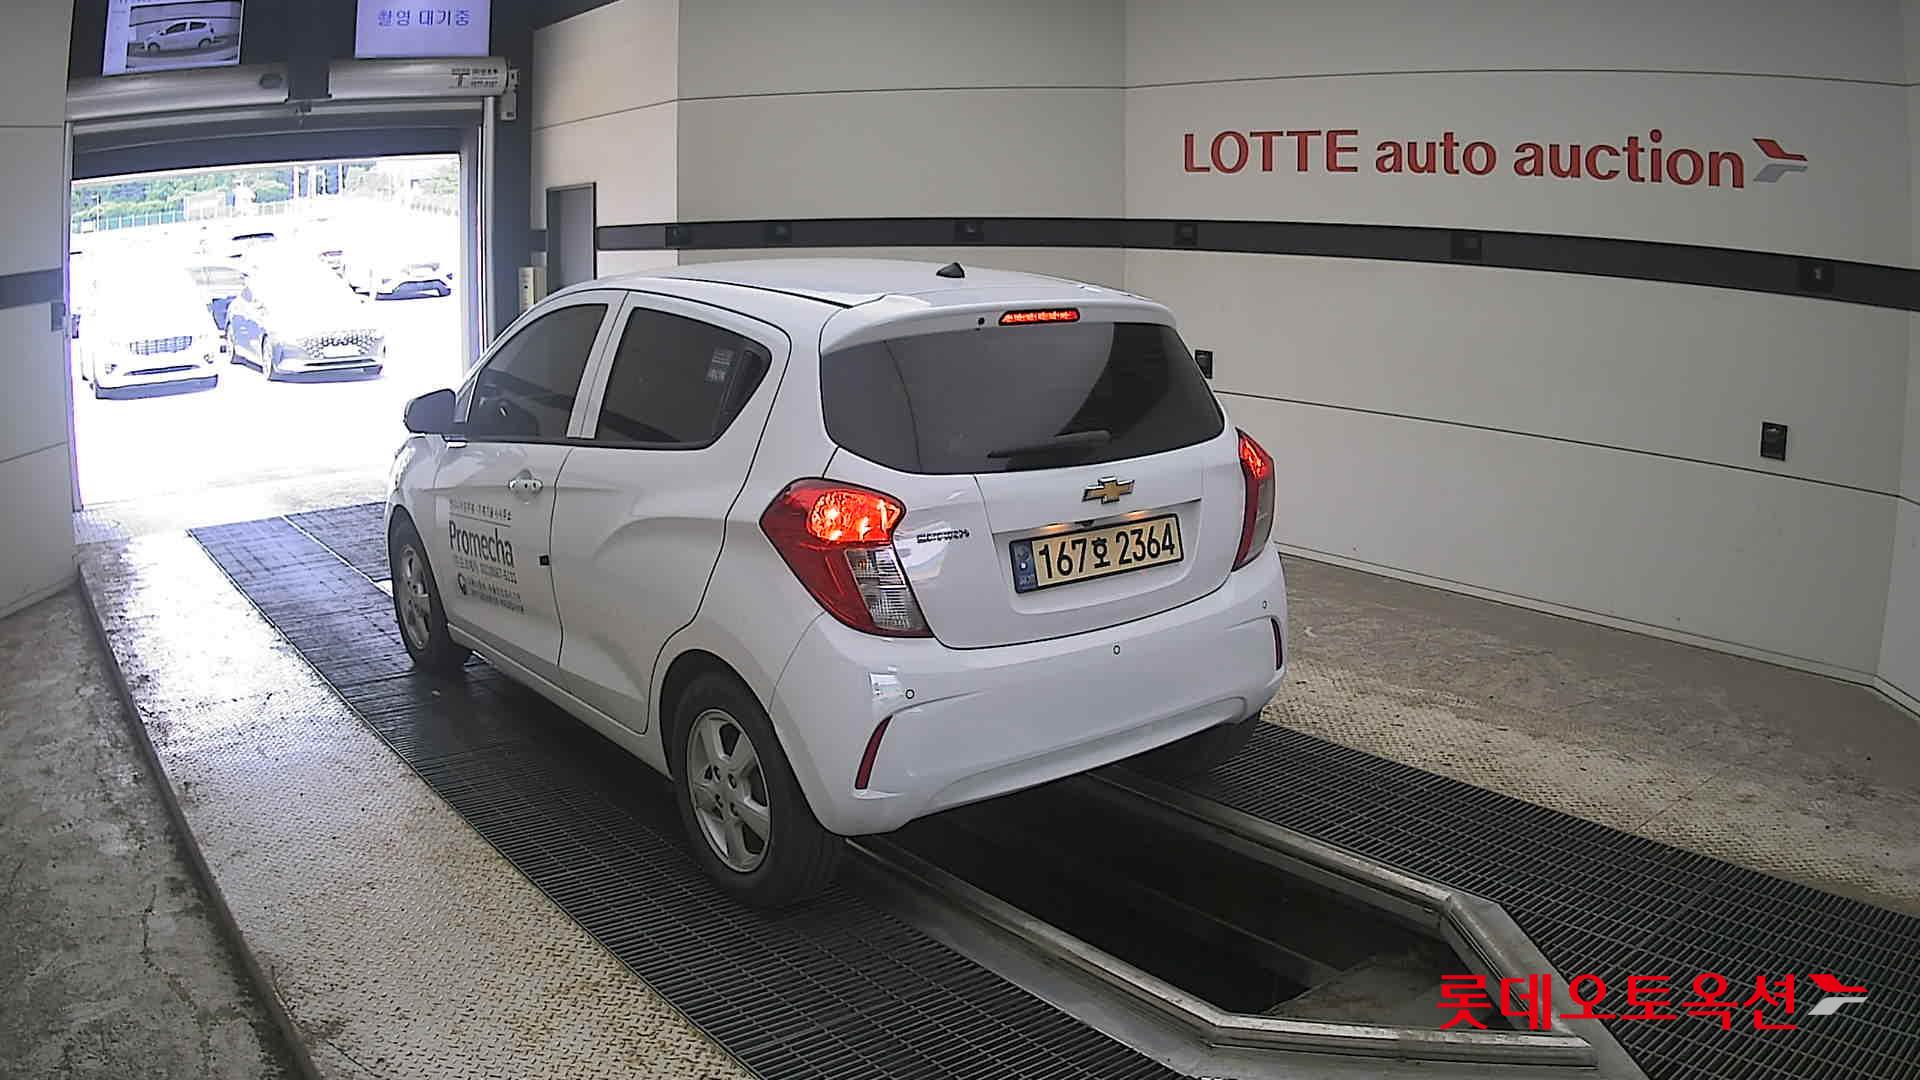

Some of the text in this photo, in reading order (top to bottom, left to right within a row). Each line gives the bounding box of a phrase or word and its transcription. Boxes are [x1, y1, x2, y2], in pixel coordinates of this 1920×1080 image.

[419, 9, 471, 26] 대기중
[1184, 129, 1746, 189] LOTTE auto auction
[448, 519, 515, 569] Promecha
[1038, 523, 1175, 578] 167호 2364
